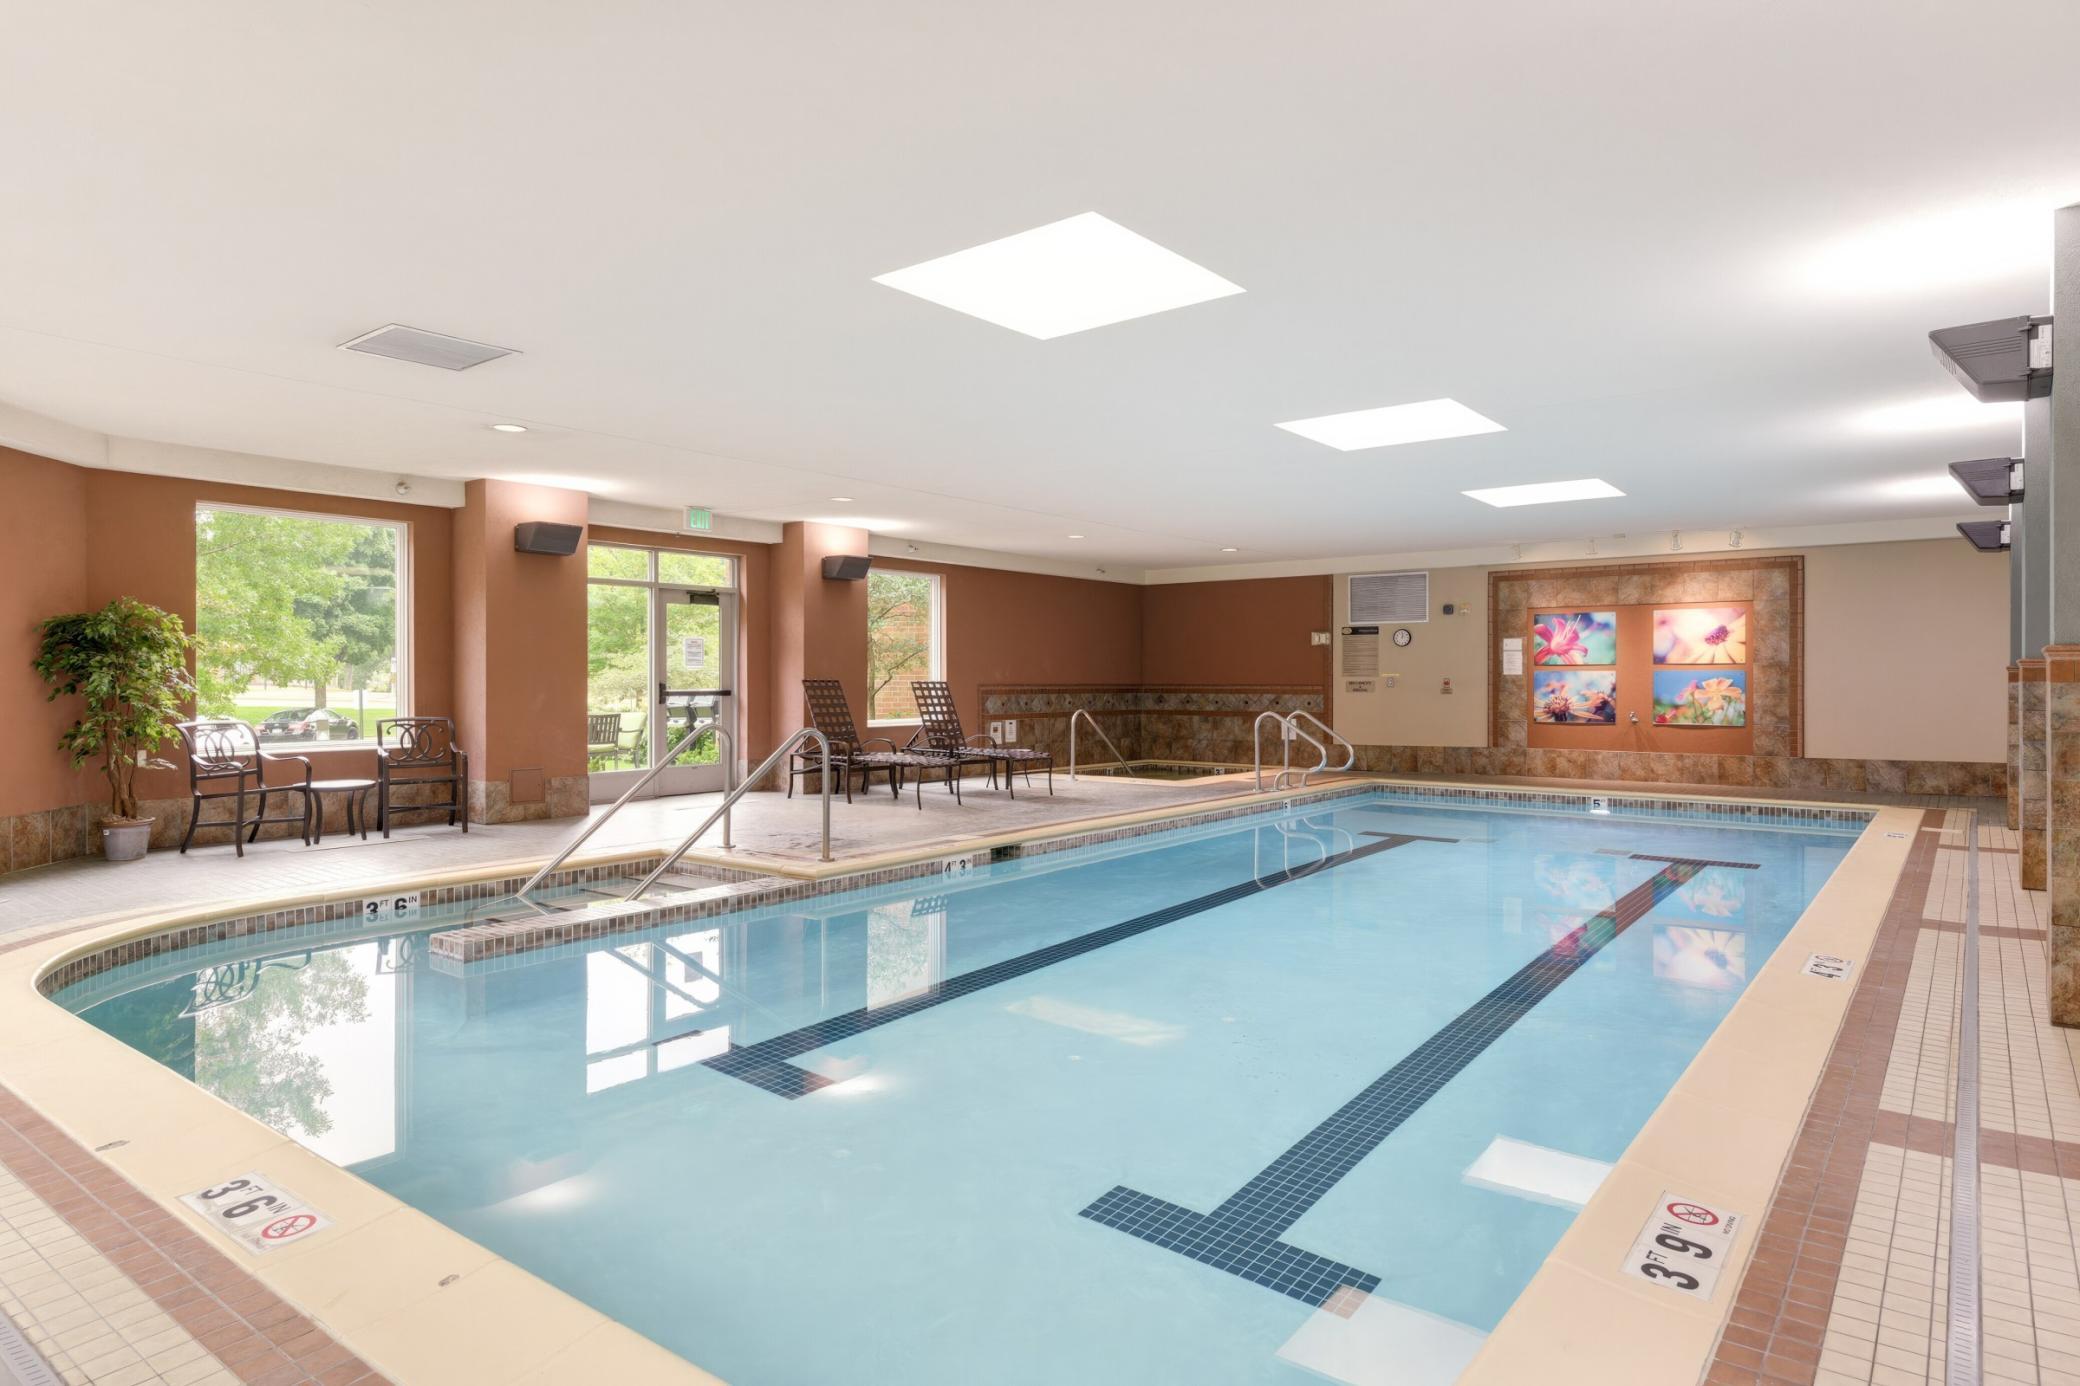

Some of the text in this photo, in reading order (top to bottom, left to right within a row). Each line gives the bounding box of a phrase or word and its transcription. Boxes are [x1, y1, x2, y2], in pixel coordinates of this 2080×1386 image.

[690, 511, 711, 528] EXIT
[960, 859, 966, 869] 3
[366, 895, 418, 914] 3 FT 6 IN
[200, 1179, 291, 1219] 3 FT 6 IN
[1640, 1222, 1713, 1290] 3 FT 9 IN
